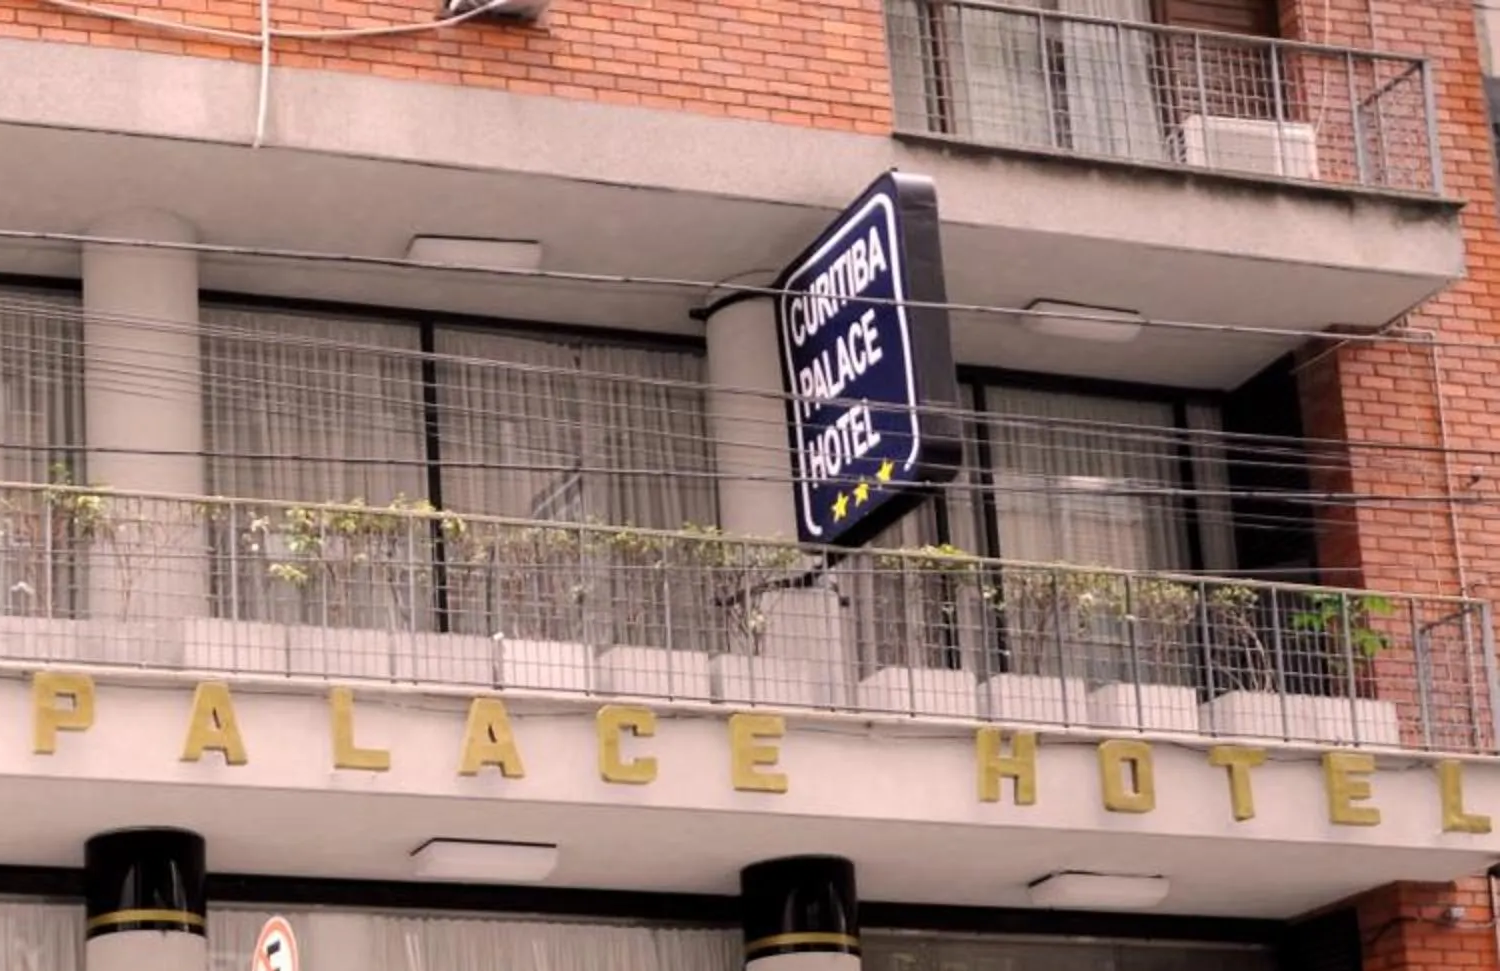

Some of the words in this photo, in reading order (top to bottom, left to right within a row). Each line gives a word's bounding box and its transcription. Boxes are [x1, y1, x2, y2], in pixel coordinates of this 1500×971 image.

[790, 226, 887, 346] CURITIBA
[800, 308, 883, 417] PALACE
[809, 397, 881, 488] HOTEL
[31, 671, 788, 793] PALACE
[975, 727, 1492, 833] HOTEL
